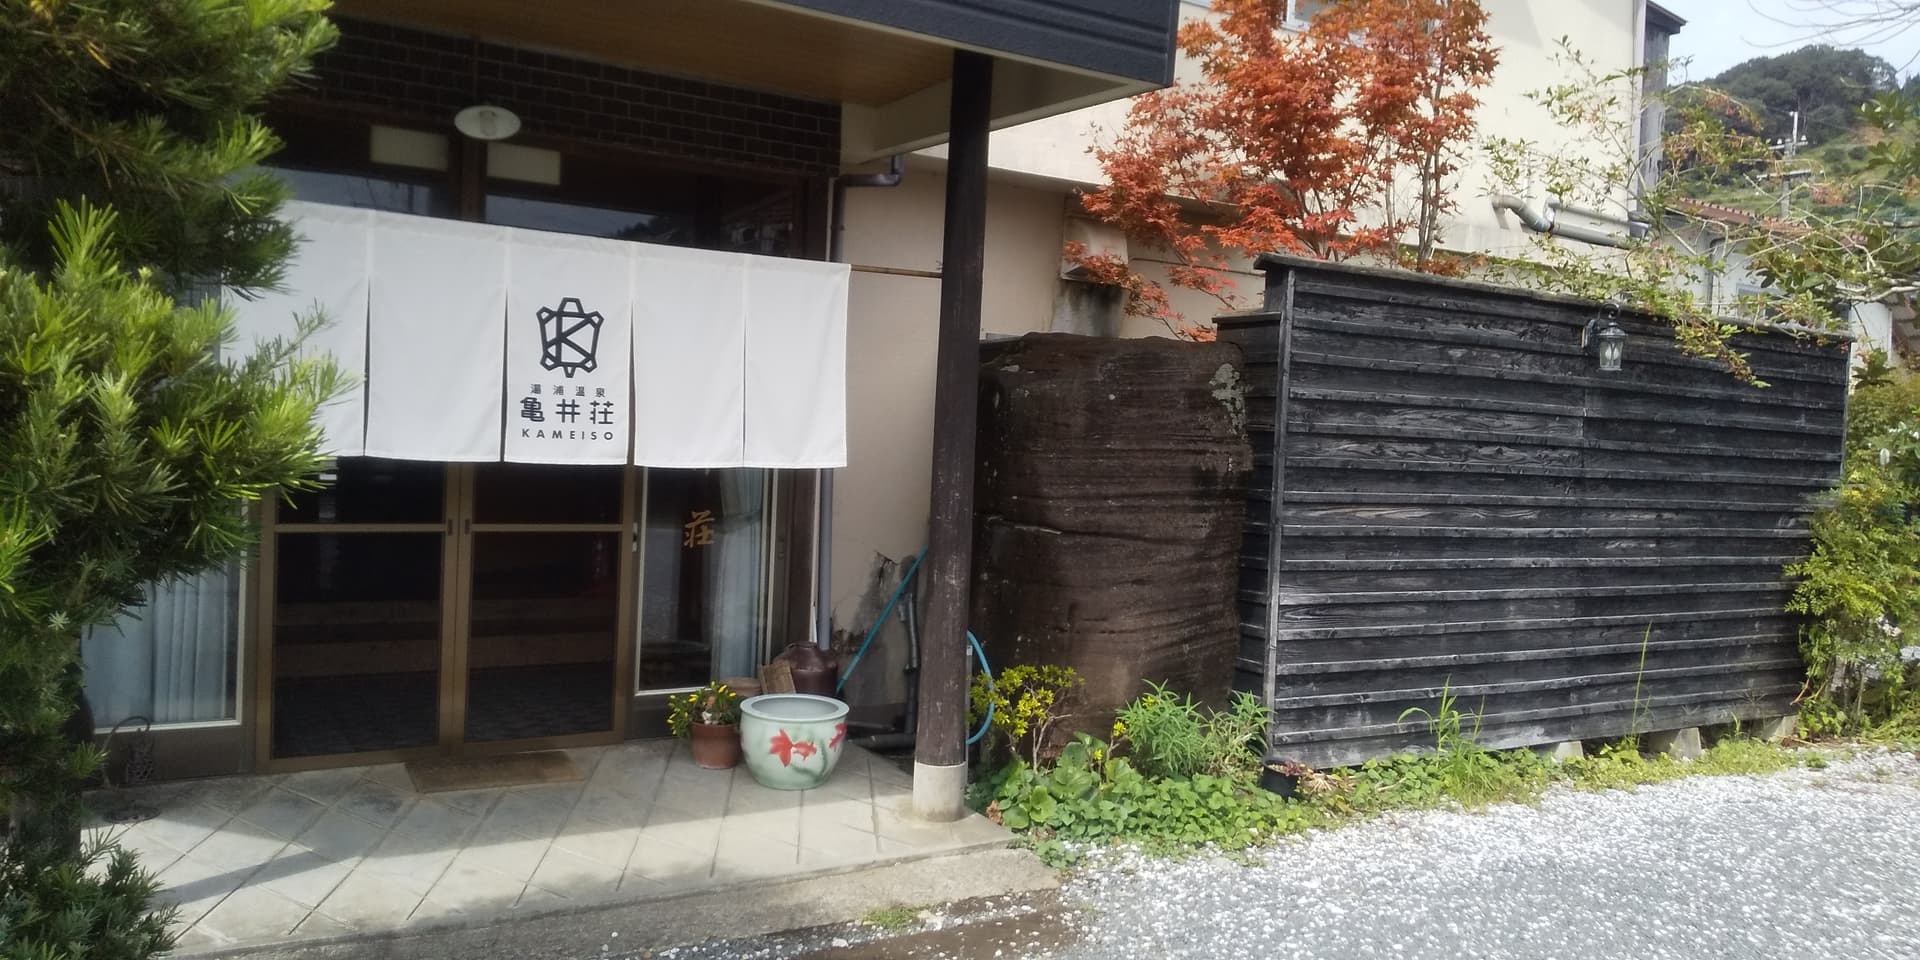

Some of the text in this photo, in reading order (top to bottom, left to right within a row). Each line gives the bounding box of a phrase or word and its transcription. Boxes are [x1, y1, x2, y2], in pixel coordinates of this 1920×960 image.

[520, 396, 614, 425] 亀井荘
[522, 429, 613, 440] KAMEISO
[684, 510, 716, 548] 荘
